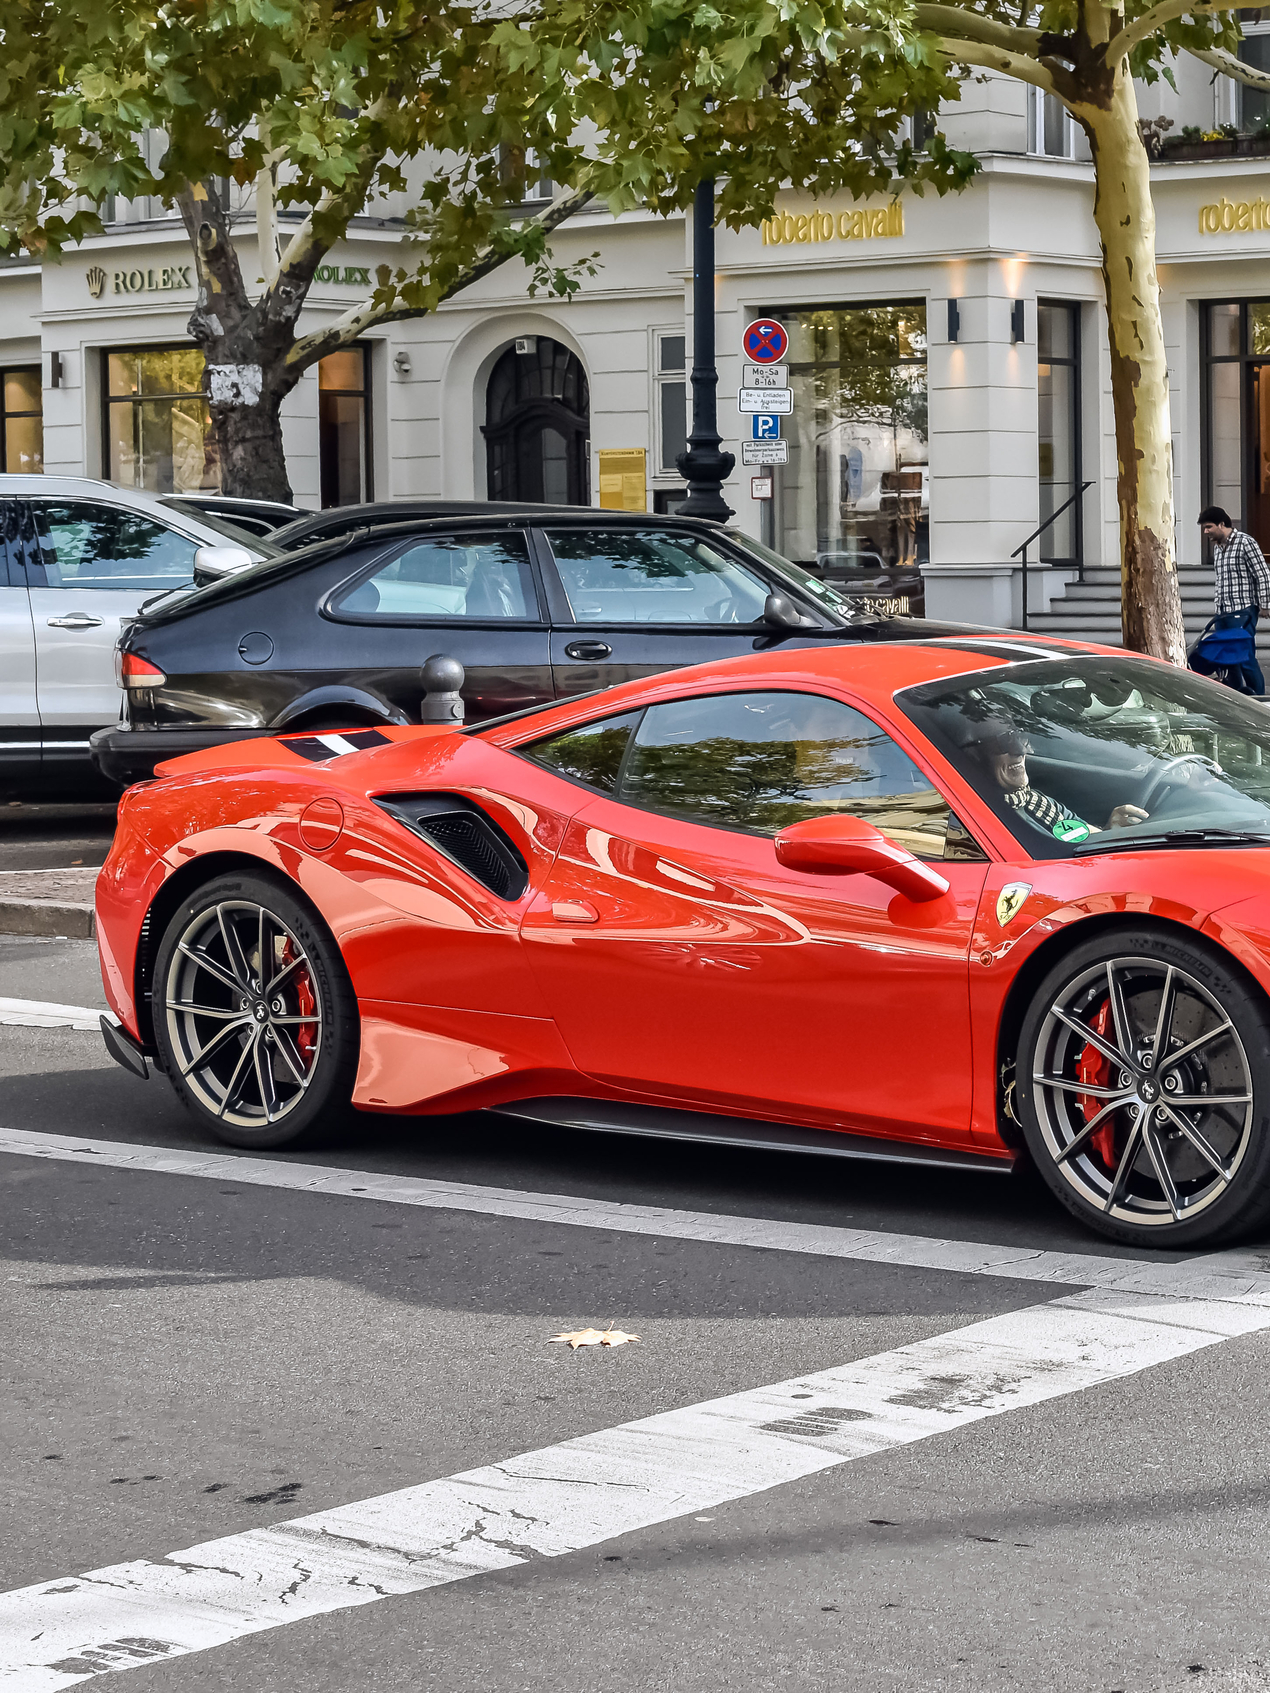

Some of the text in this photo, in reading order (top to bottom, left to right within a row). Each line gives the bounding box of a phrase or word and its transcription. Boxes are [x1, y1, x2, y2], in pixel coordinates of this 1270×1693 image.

[762, 200, 904, 245] roberto cavalli
[113, 265, 191, 294] ROLEX
[752, 367, 779, 376] Mo-Sa
[758, 416, 774, 437] P
[1163, 943, 1214, 979] MICHELIN
